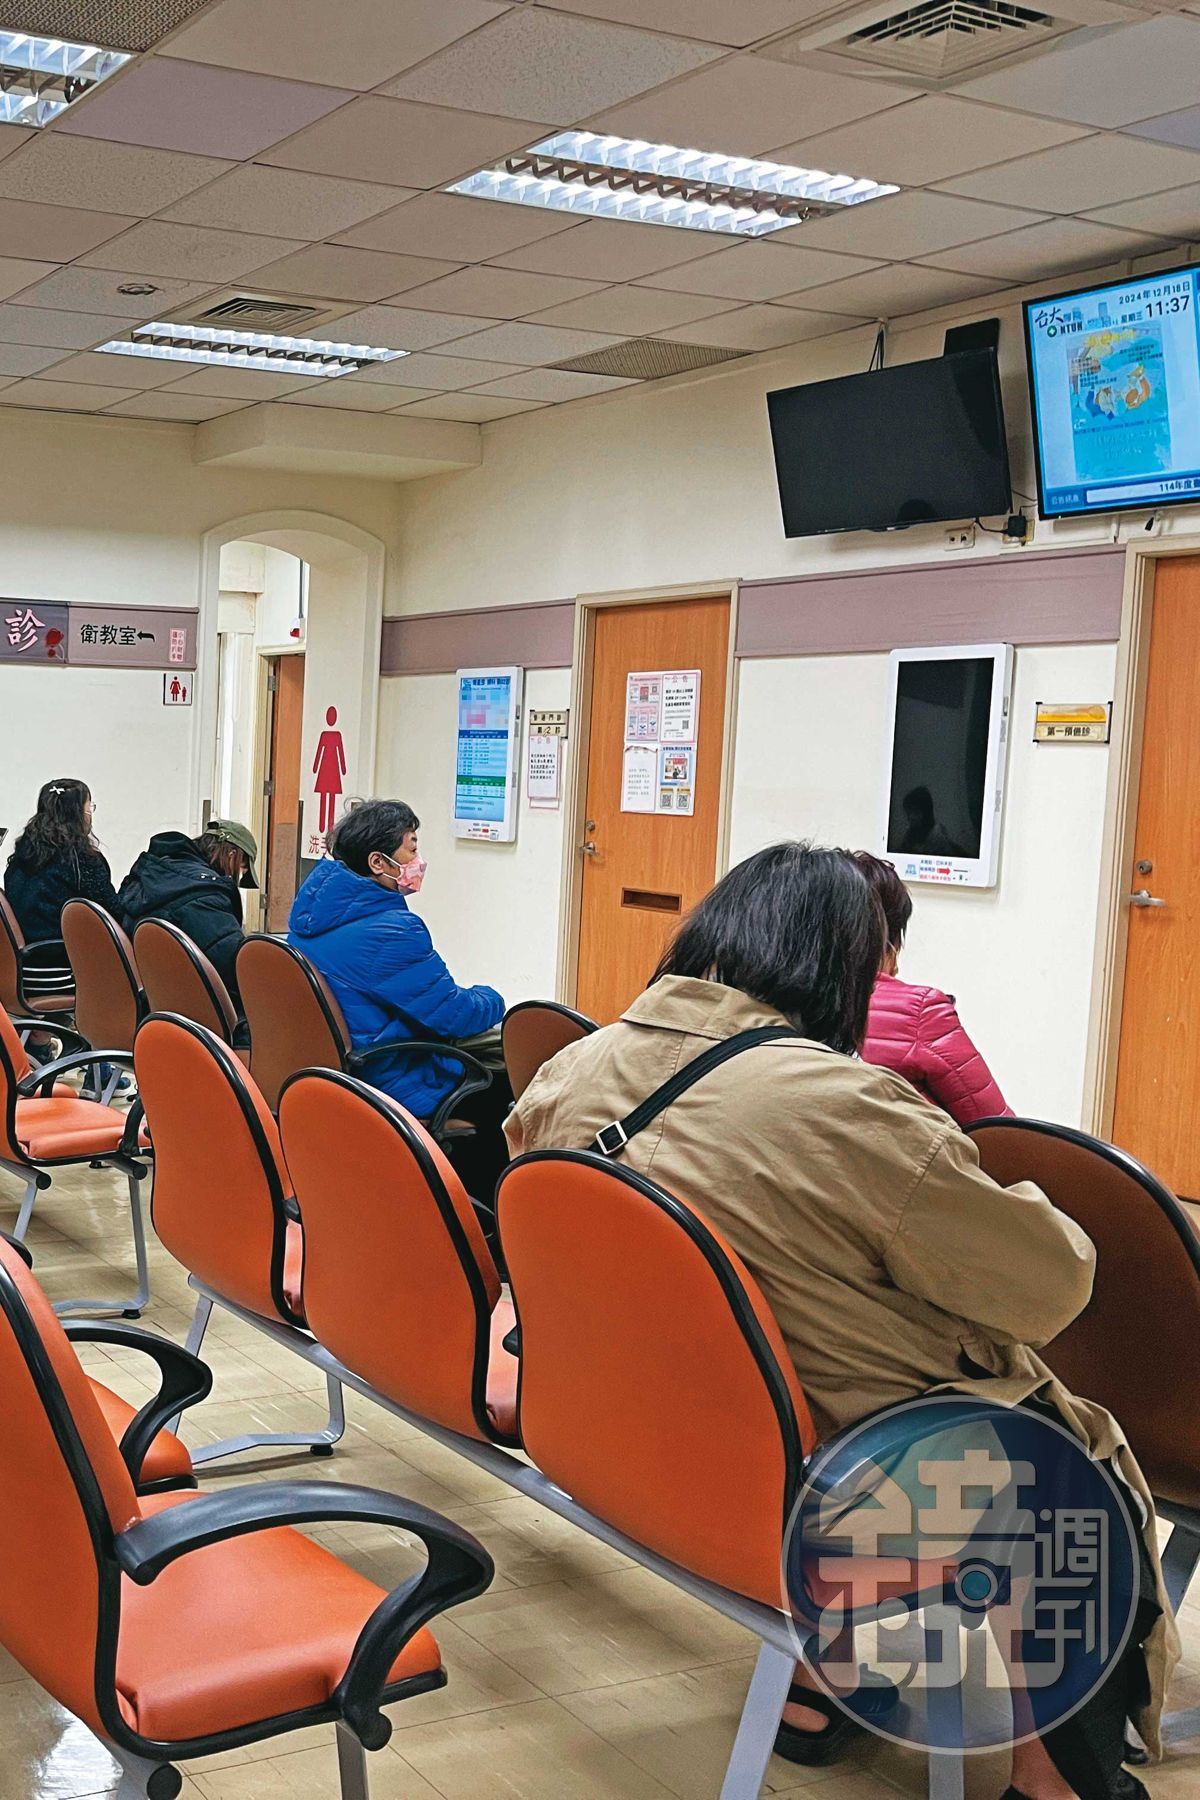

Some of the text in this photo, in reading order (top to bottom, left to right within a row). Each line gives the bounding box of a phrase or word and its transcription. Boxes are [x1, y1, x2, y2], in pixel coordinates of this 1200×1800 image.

[1145, 295, 1190, 318] 11:37
[80, 623, 137, 646] 衛教室
